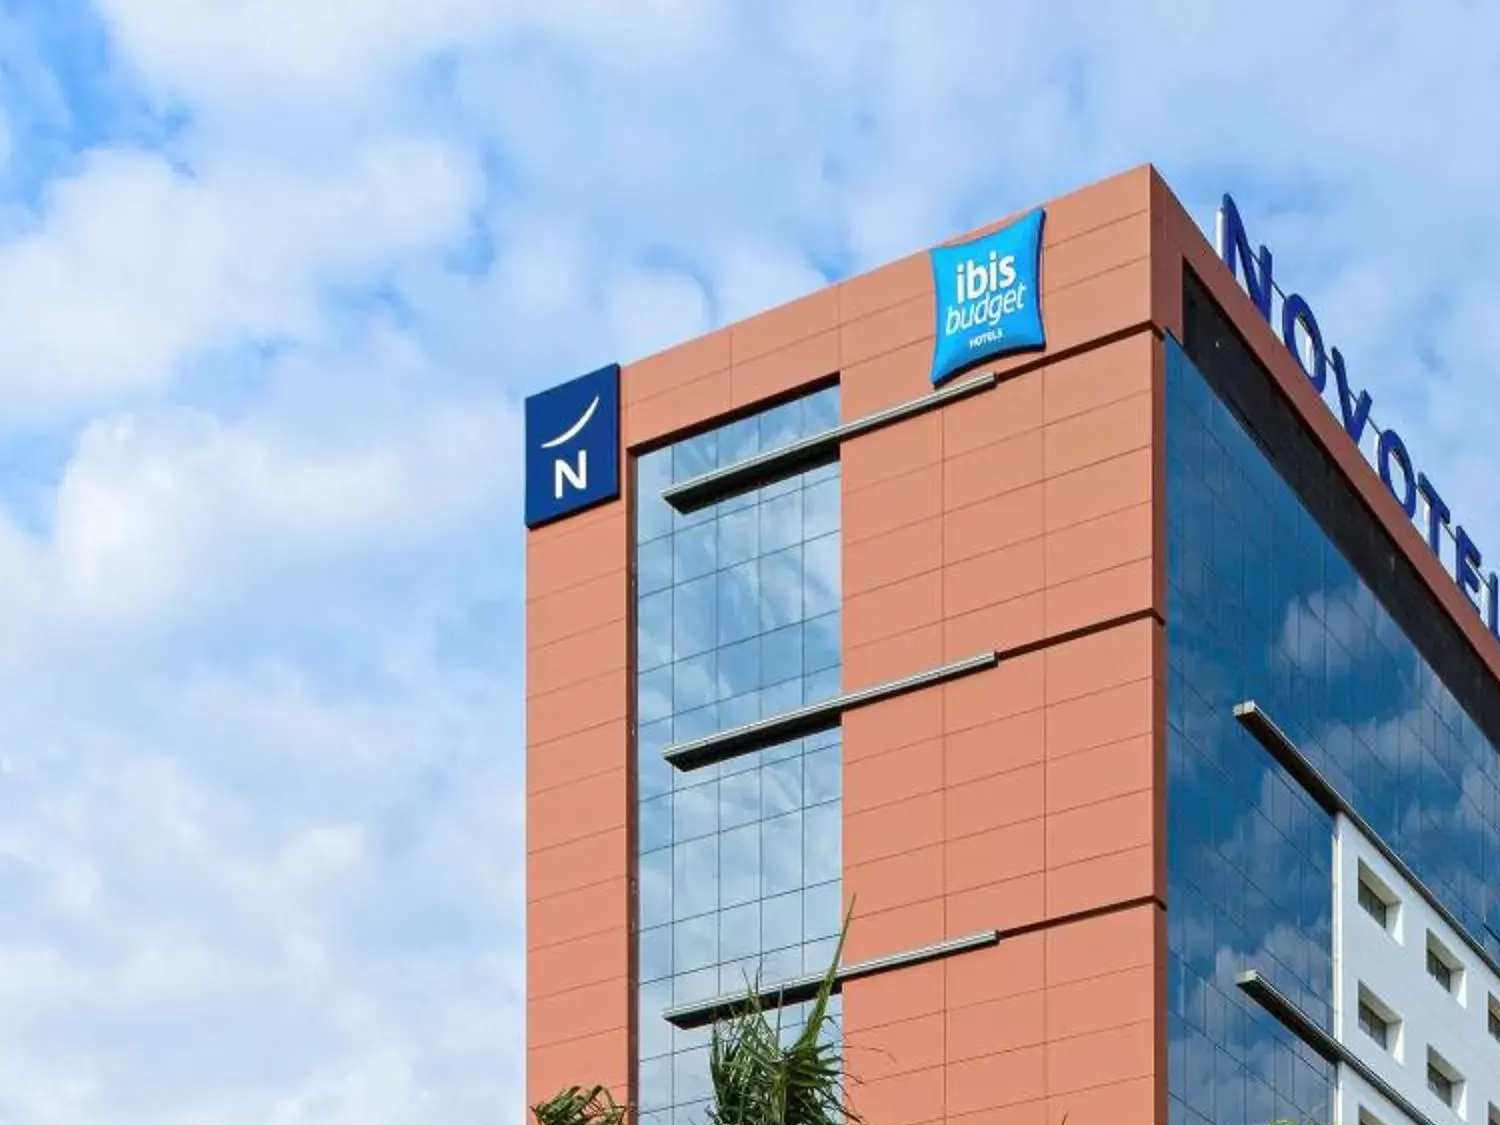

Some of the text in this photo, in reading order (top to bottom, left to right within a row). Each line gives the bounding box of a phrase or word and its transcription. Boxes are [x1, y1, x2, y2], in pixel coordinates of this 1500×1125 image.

[956, 251, 1017, 304] ibis
[945, 281, 1028, 336] budget
[554, 449, 587, 499] N
